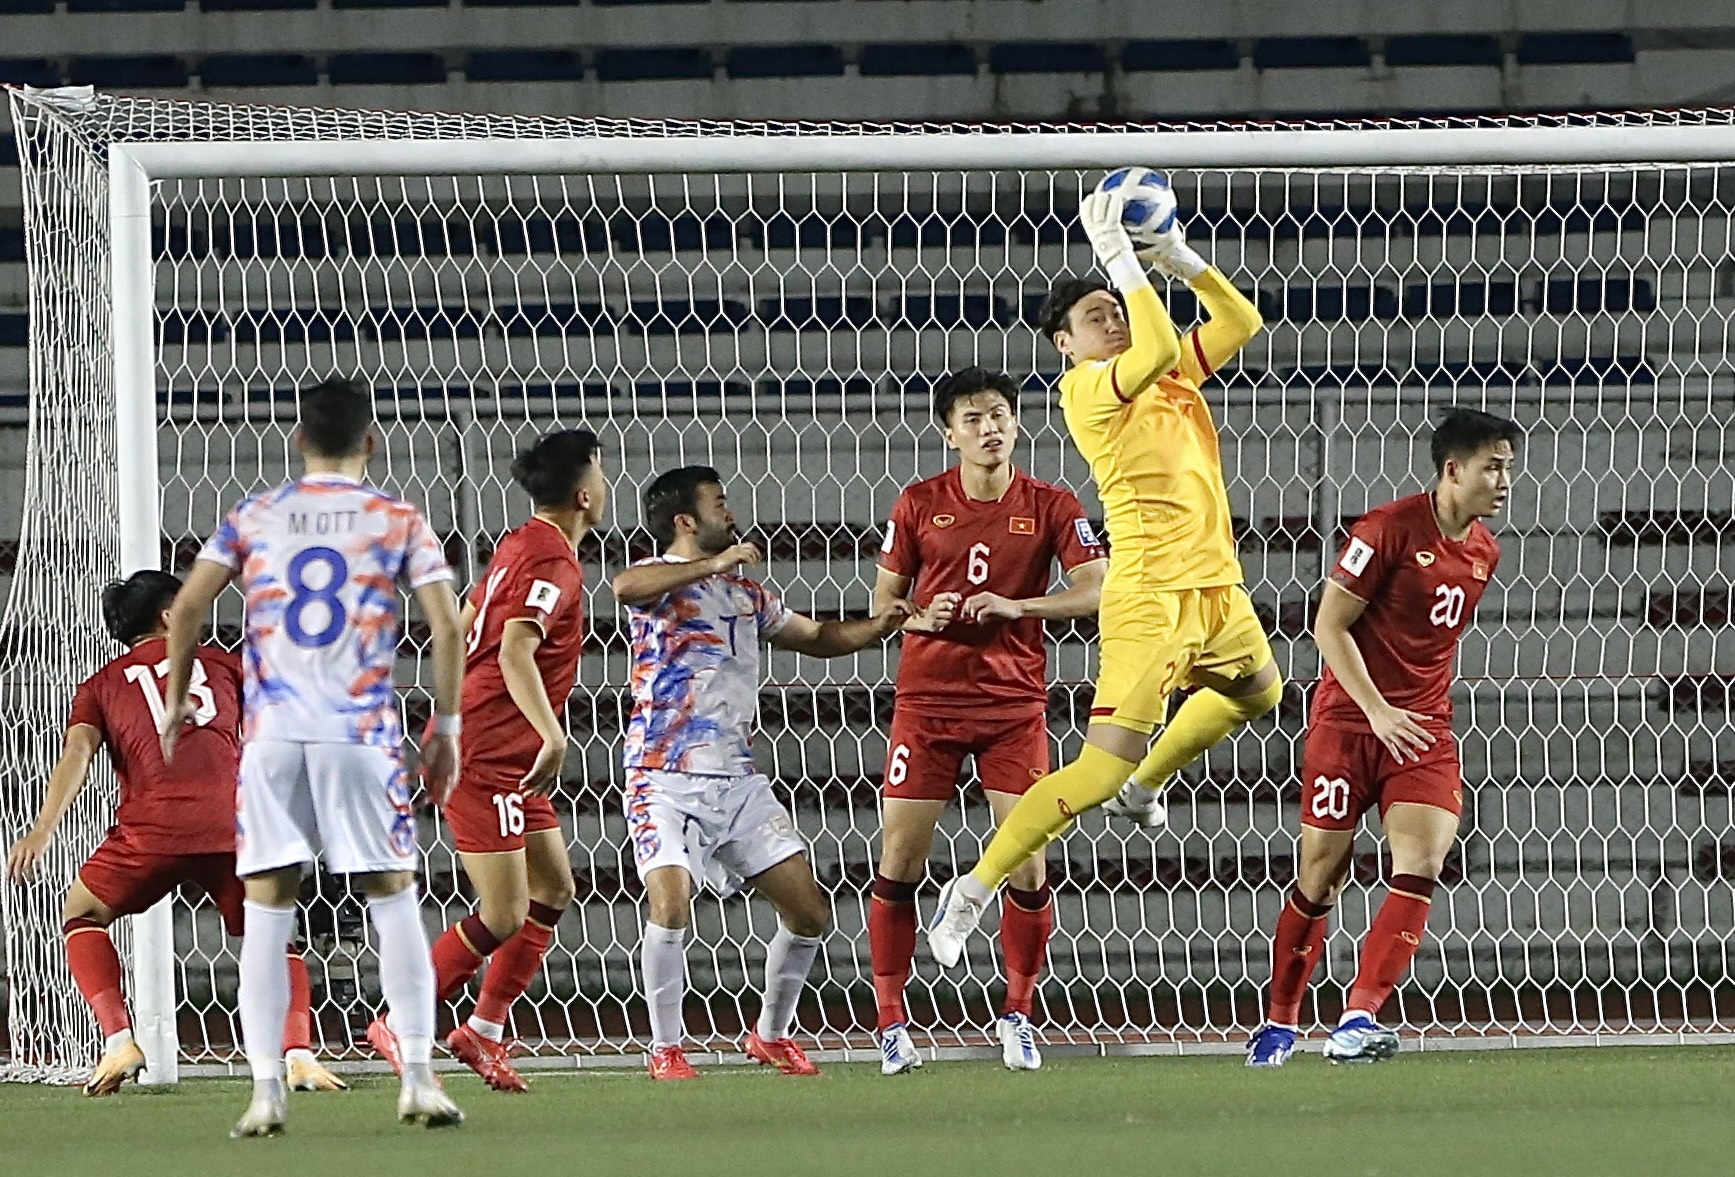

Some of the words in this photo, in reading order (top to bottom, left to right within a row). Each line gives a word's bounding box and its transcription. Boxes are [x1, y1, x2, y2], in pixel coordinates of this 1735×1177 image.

[966, 541, 990, 585] 6
[285, 546, 347, 647] 8
[1429, 583, 1465, 628] 20
[719, 615, 737, 656] 7
[888, 743, 911, 786] 6
[492, 792, 525, 837] 16
[1312, 775, 1350, 820] 20
